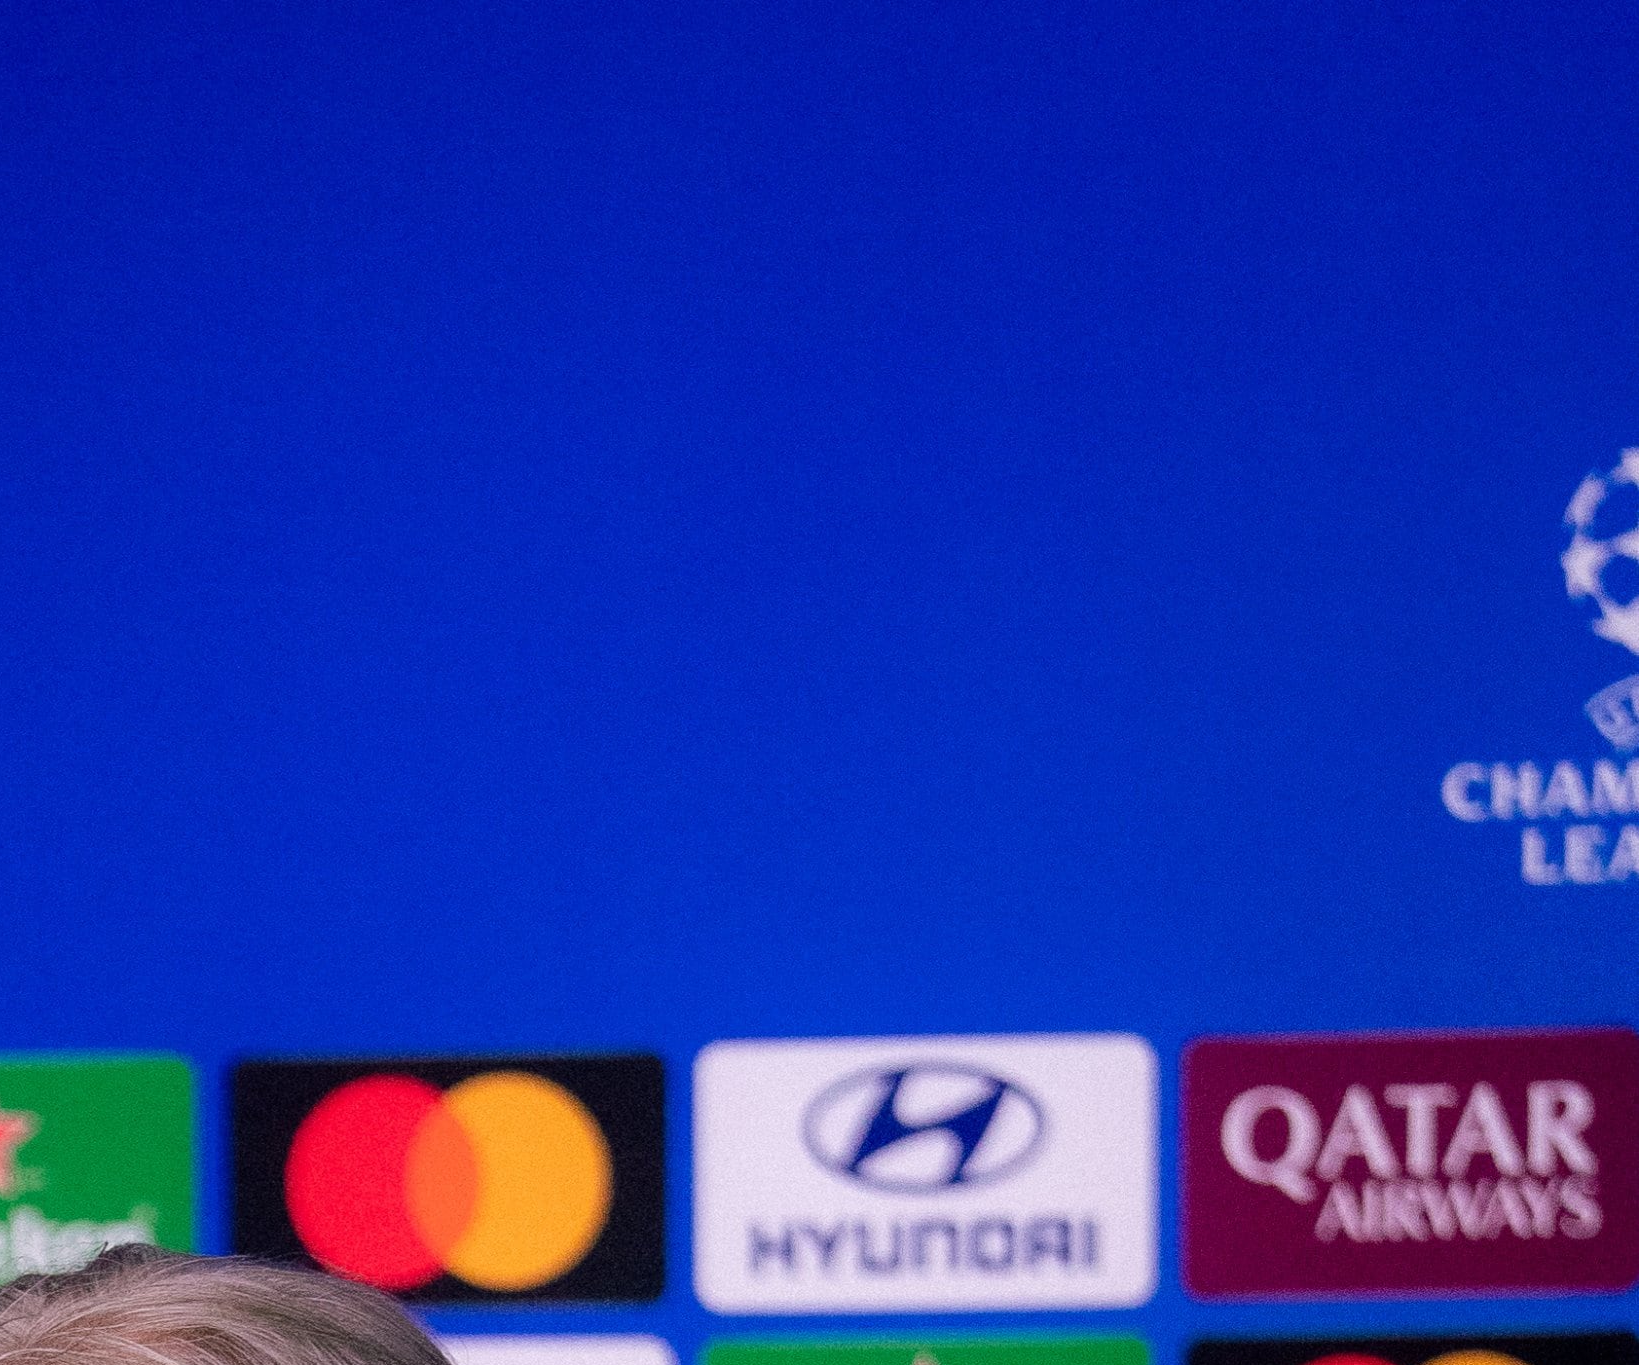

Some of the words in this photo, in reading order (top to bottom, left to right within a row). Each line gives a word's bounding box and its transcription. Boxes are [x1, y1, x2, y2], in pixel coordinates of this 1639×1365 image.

[1442, 760, 1639, 822] CHAM
[1521, 825, 1639, 885] LEA
[1220, 1081, 1598, 1203] QATAR
[1315, 1176, 1603, 1242] AIRWAYS
[748, 1216, 1100, 1278] HYUNDAI
